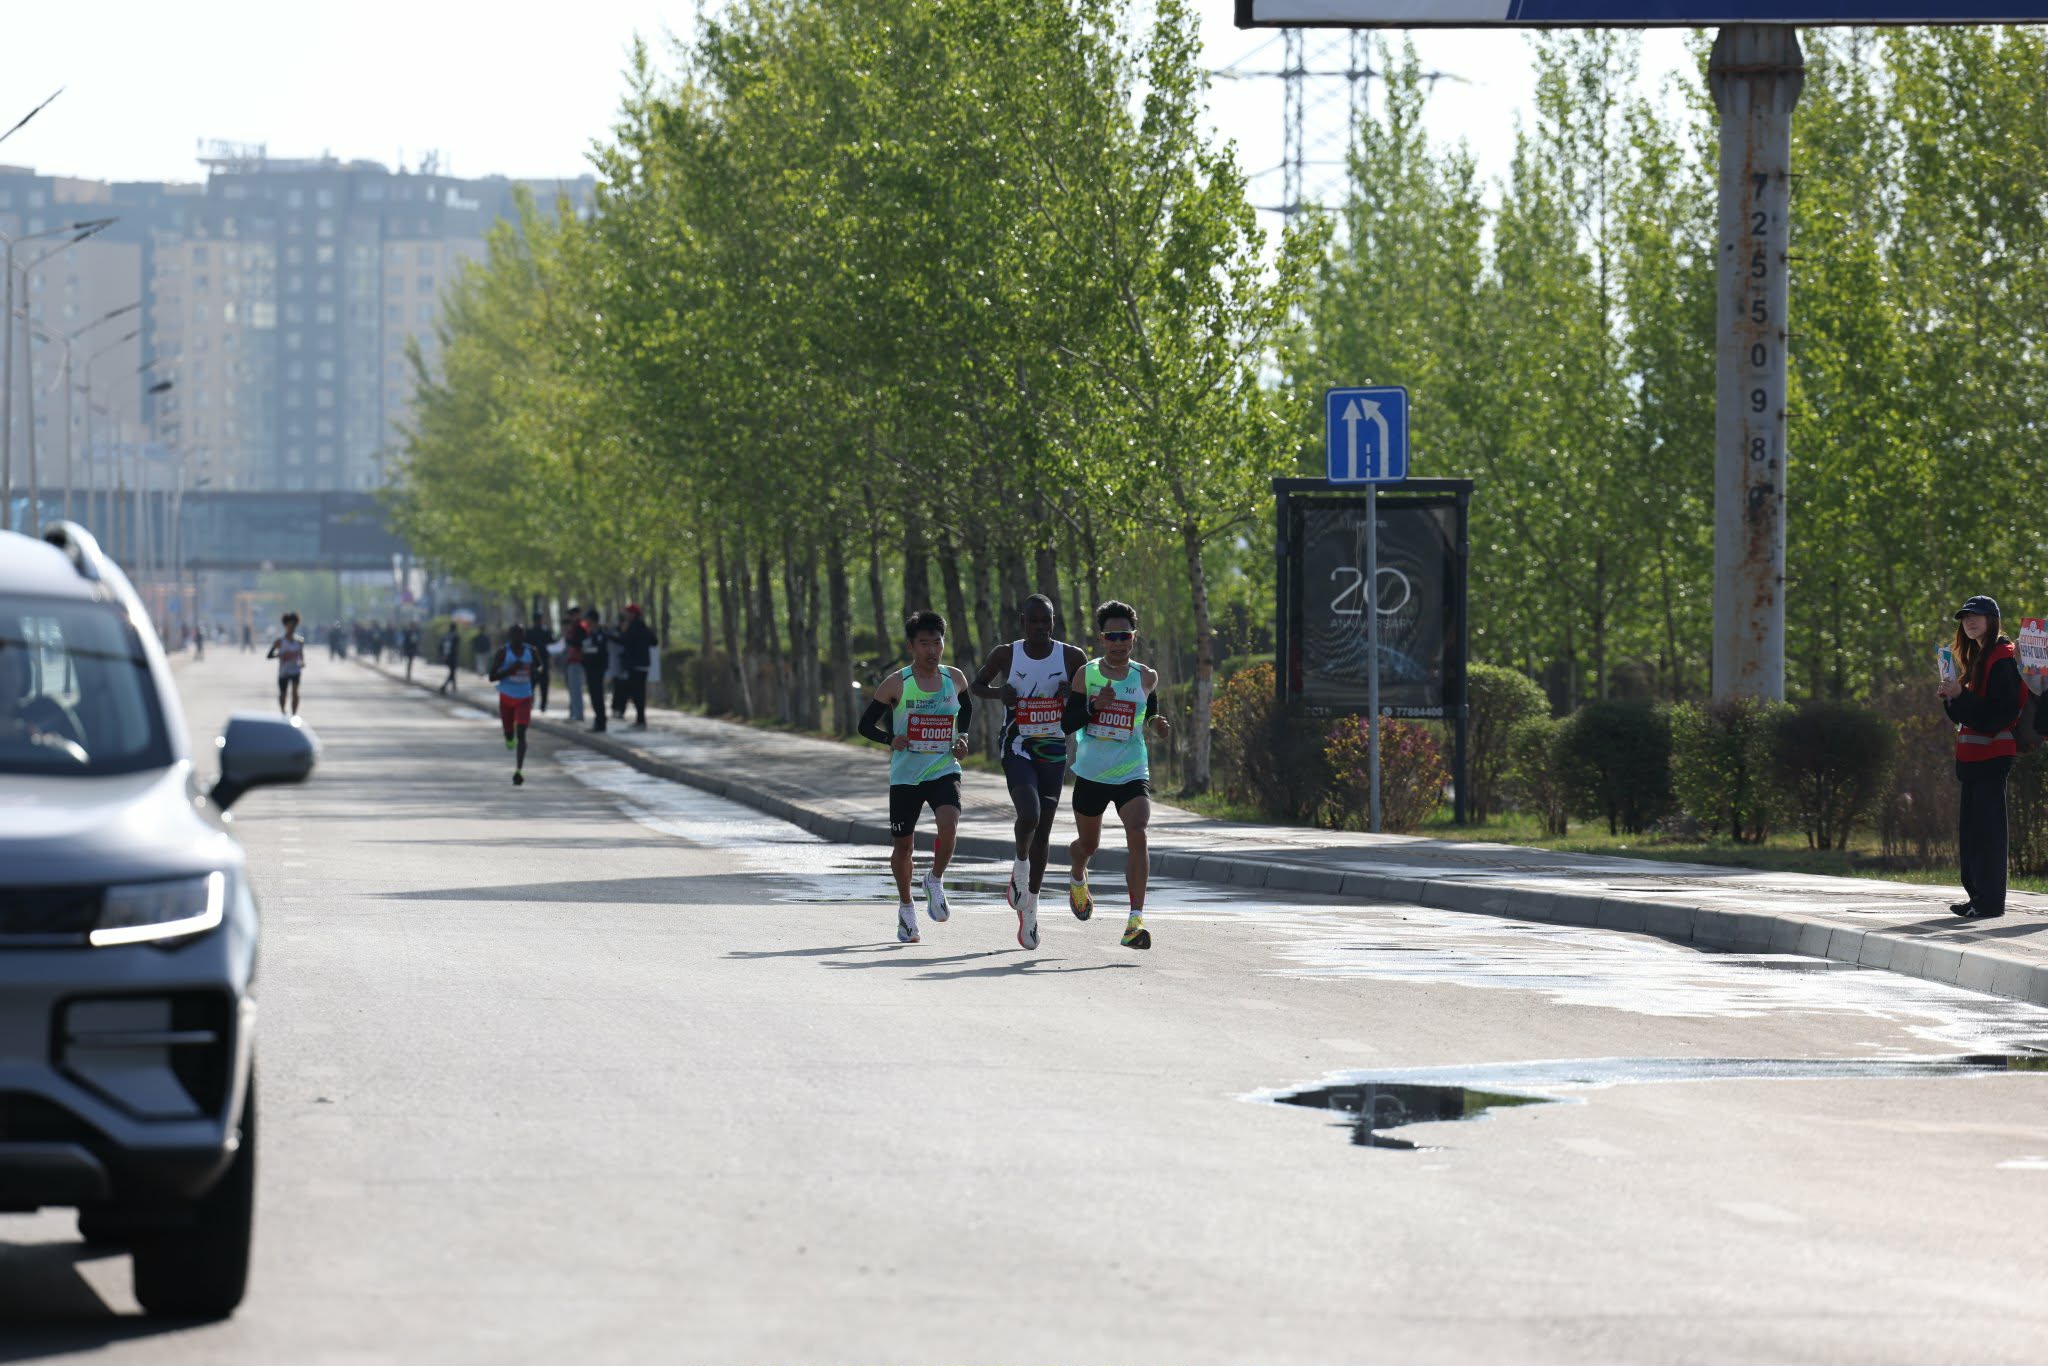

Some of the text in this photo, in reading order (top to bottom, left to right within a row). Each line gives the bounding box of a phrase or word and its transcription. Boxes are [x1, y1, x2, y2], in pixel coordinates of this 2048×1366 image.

[1330, 567, 1411, 615] 20
[1330, 618, 1415, 629] ANNIVRSARY
[1030, 709, 1063, 723] 00004
[1099, 712, 1132, 727] 00001
[921, 728, 952, 739] 00002
